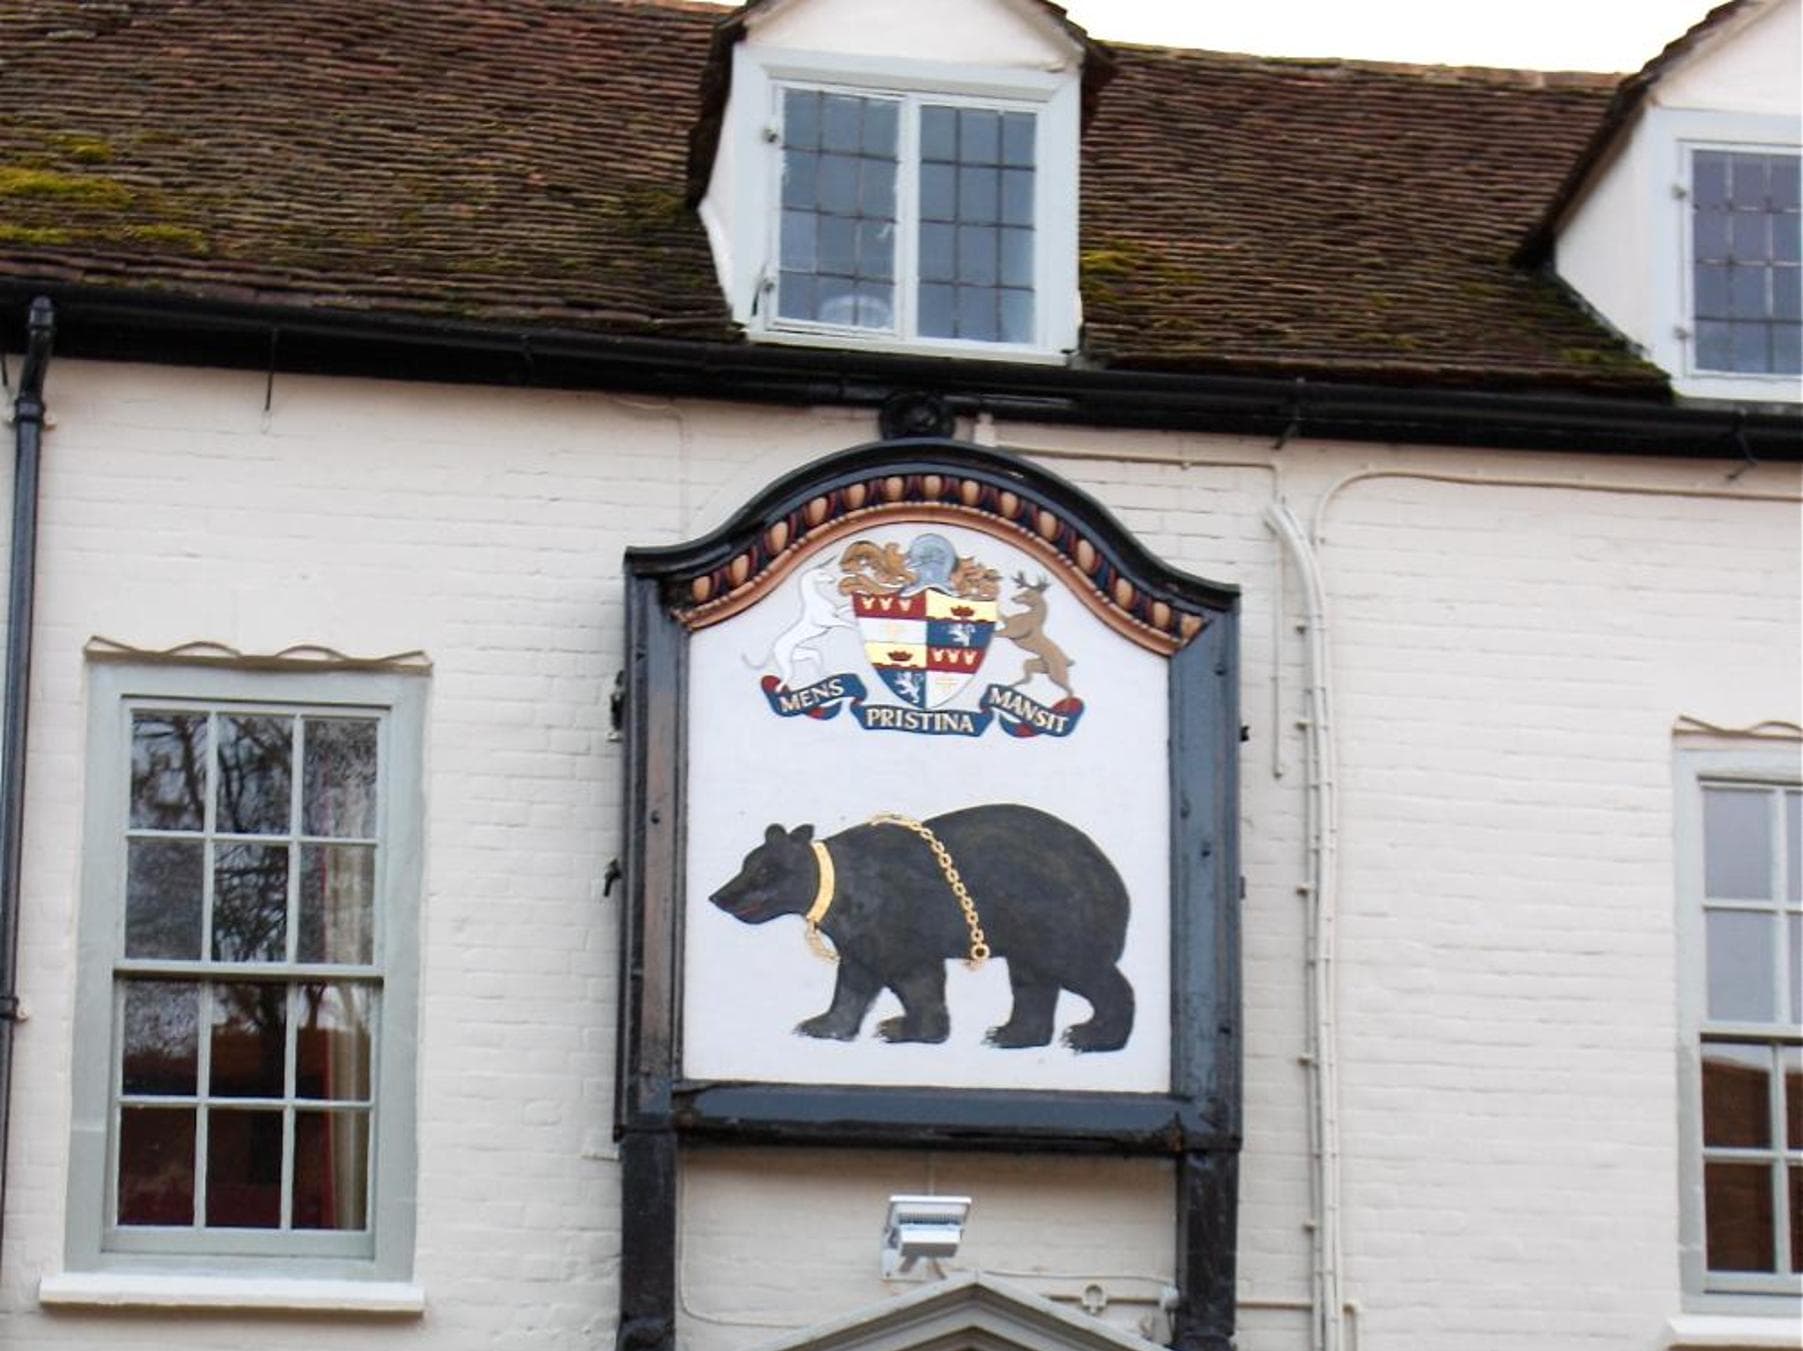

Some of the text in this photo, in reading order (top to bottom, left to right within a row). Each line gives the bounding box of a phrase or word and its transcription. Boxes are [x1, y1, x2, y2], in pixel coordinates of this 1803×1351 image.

[779, 678, 1070, 733] MENS PRISTINA MANSIT
